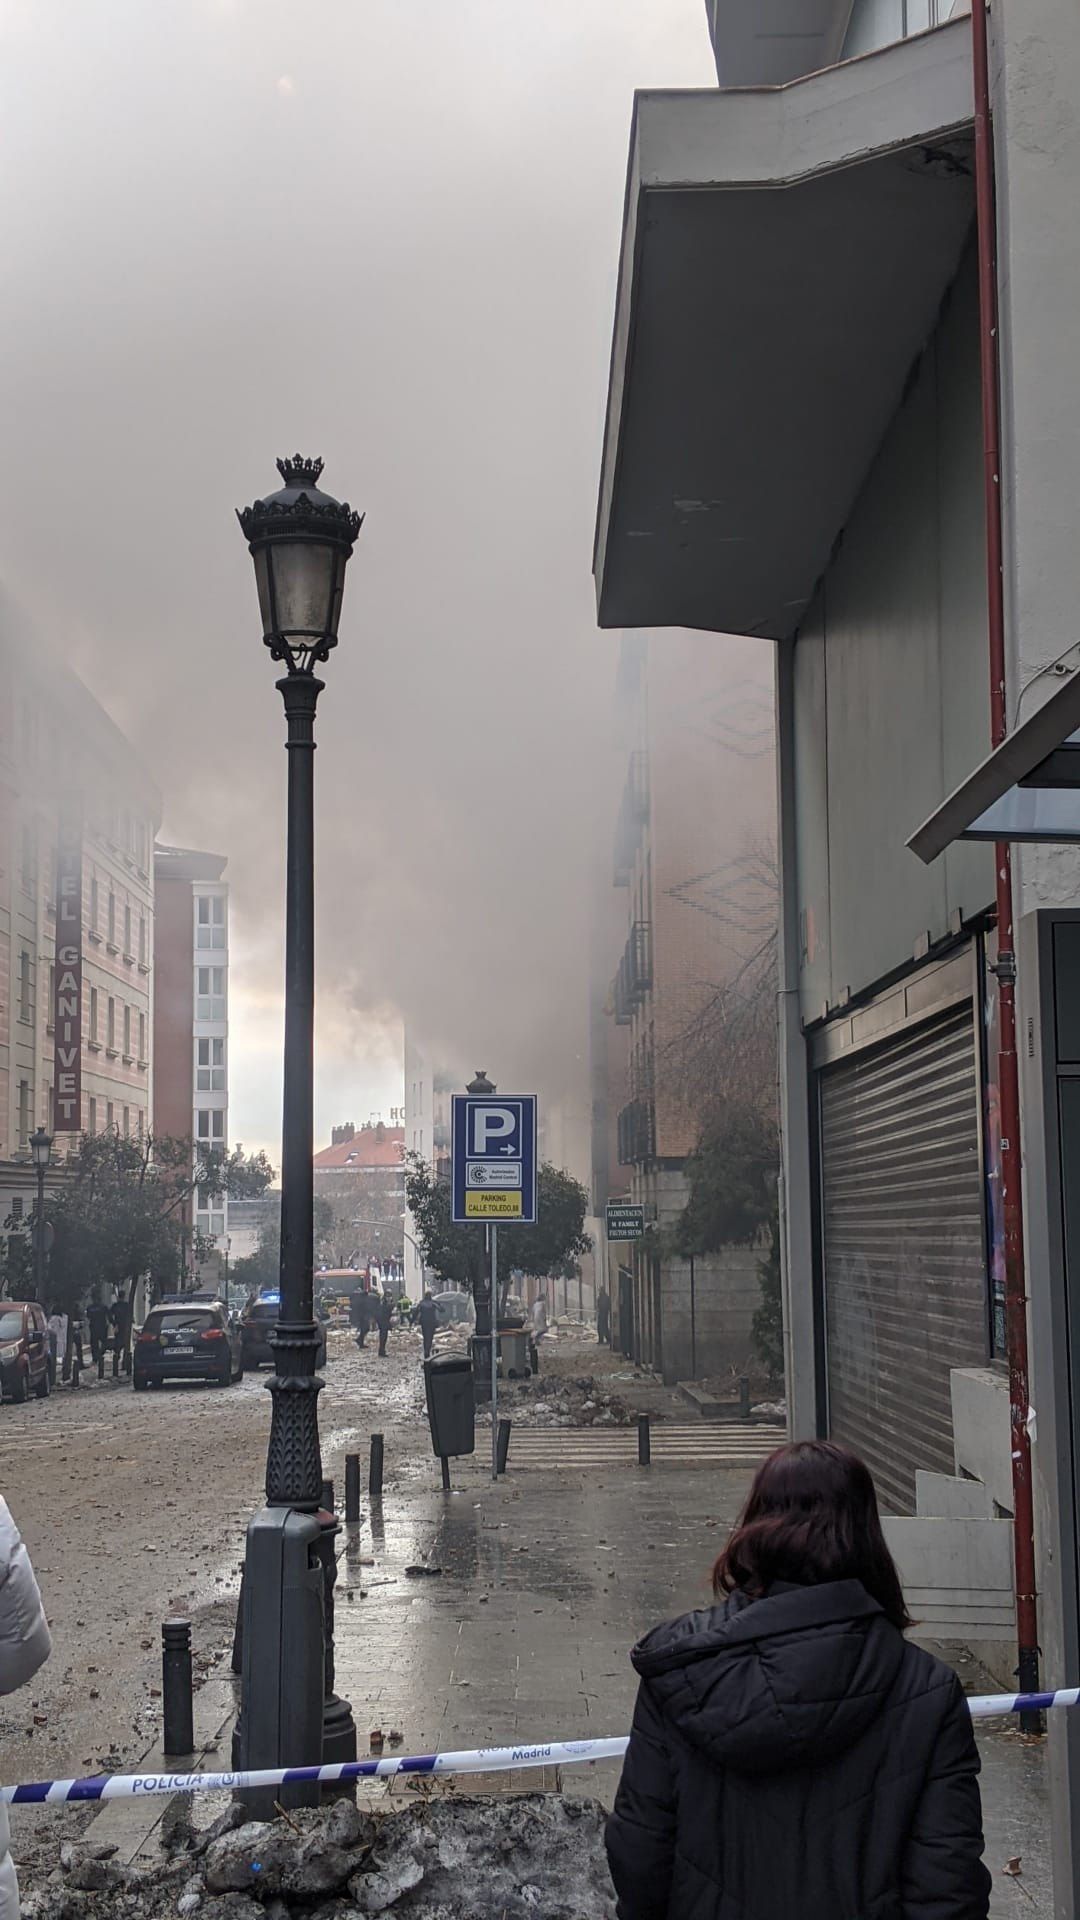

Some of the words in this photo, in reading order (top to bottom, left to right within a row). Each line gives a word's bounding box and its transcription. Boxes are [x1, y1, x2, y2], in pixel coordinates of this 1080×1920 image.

[57, 945, 79, 1119] GANIVET
[473, 1107, 516, 1153] P
[480, 1194, 507, 1202] PARKING
[468, 1204, 488, 1212] CALLE
[511, 1747, 551, 1761] Madrid
